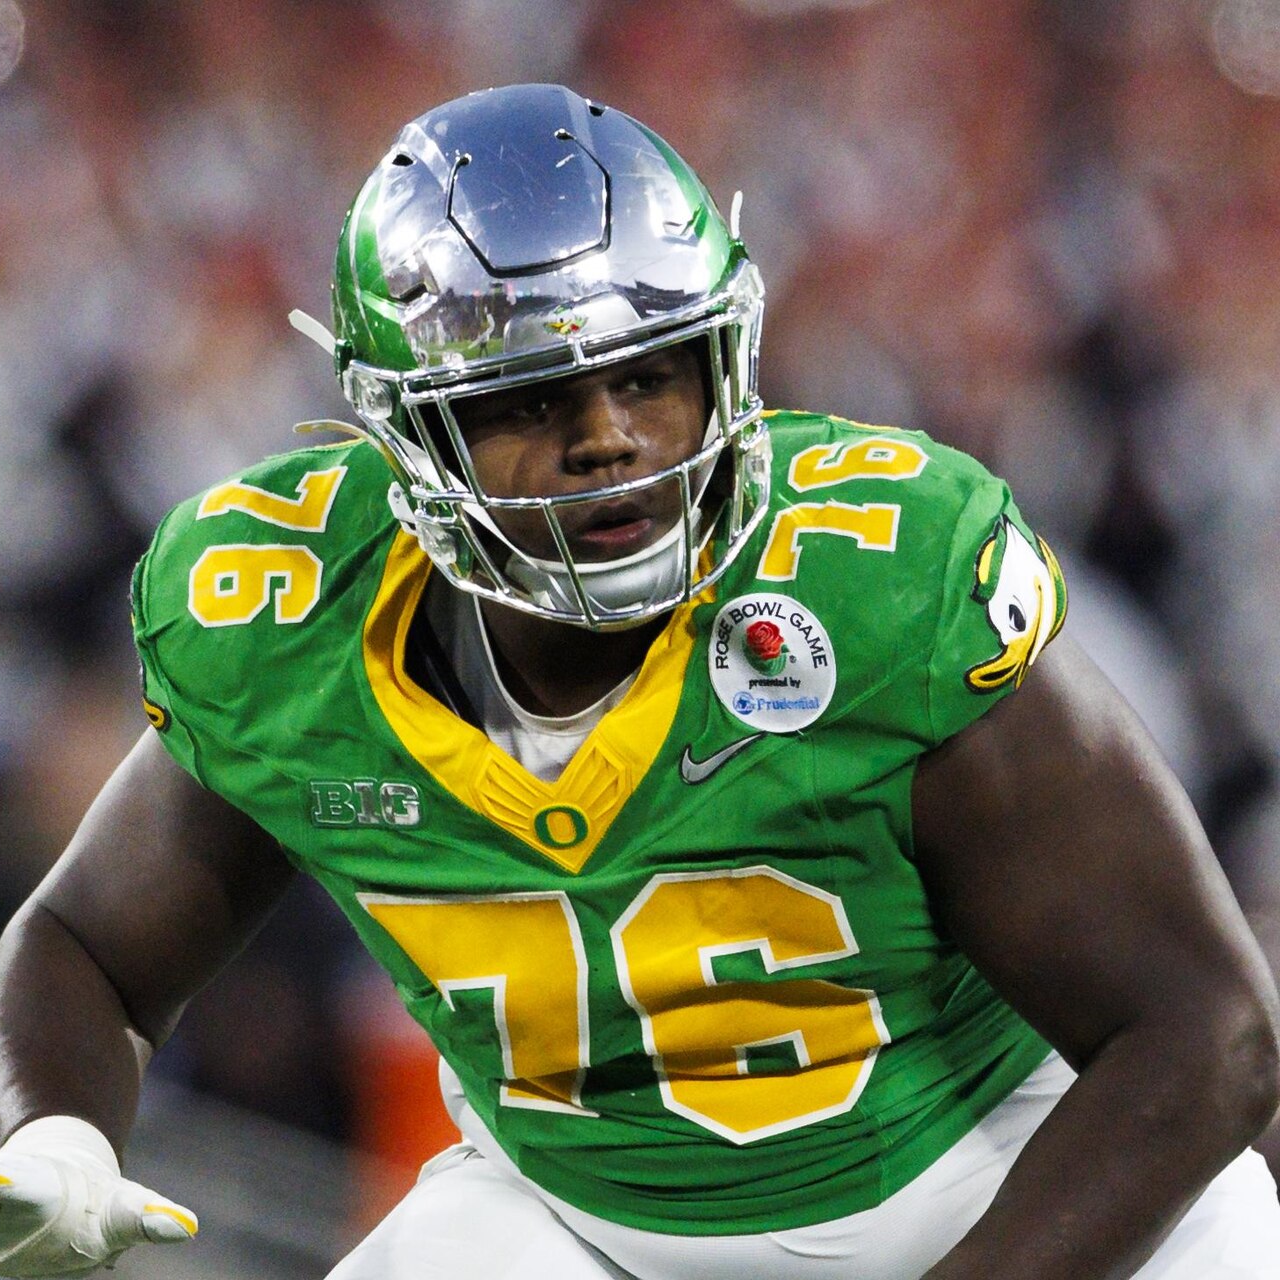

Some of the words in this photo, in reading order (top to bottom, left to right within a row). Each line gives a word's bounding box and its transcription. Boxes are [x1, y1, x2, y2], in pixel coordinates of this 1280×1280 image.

[188, 465, 349, 628] 76
[756, 437, 930, 582] 76
[715, 618, 734, 670] ROSE
[729, 601, 787, 625] BOWL
[789, 612, 828, 669] GAME
[789, 676, 801, 689] by
[533, 805, 590, 848] O
[356, 864, 892, 1145] 76
